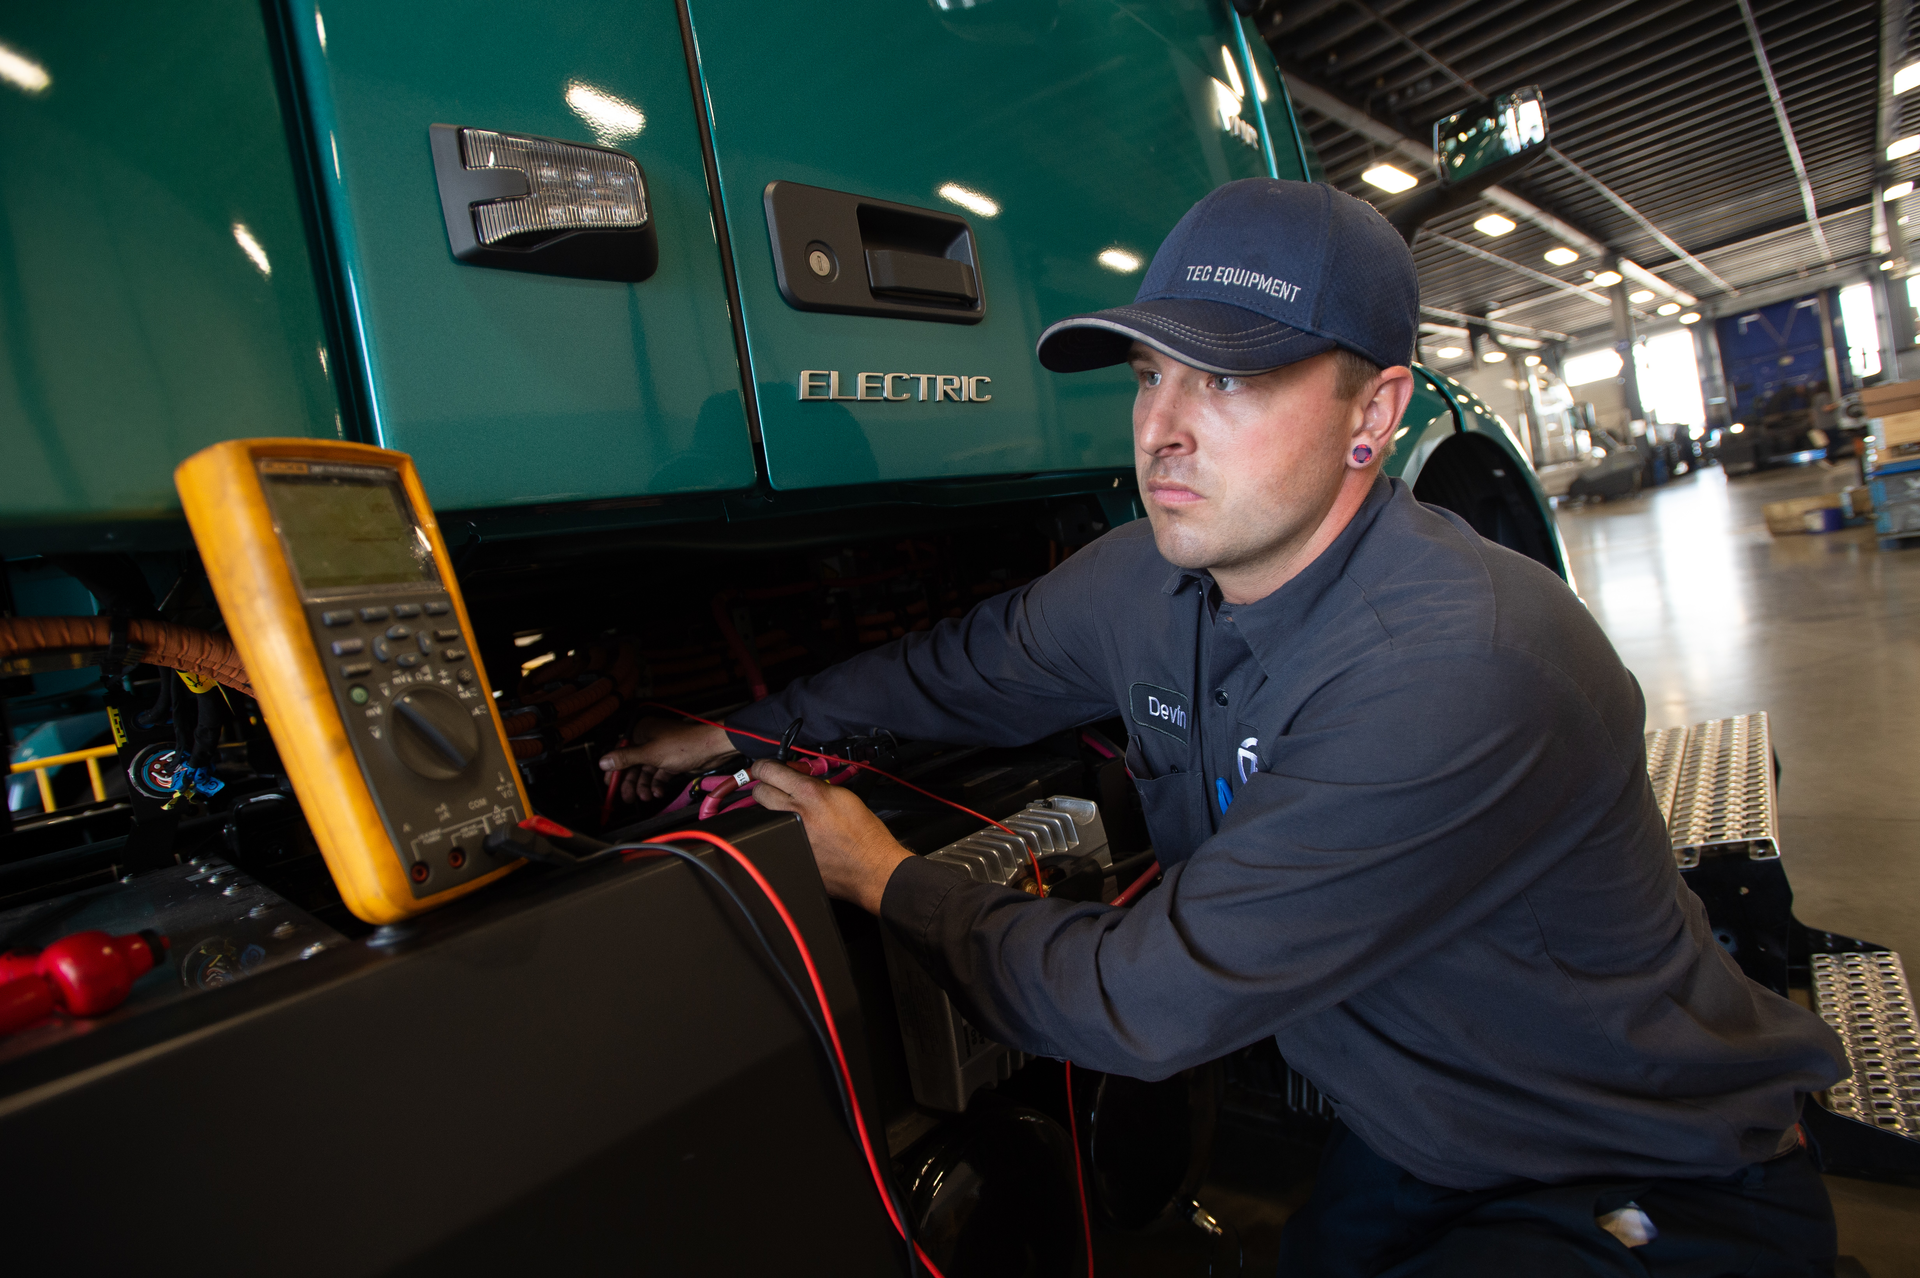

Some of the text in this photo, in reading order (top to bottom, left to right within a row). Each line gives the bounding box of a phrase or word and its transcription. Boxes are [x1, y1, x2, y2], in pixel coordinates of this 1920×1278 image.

[1186, 265, 1302, 303] TEC EQUIPMENT
[799, 369, 992, 402] ELECTRIC
[1148, 696, 1187, 730] Devin
[468, 797, 488, 811] COM
